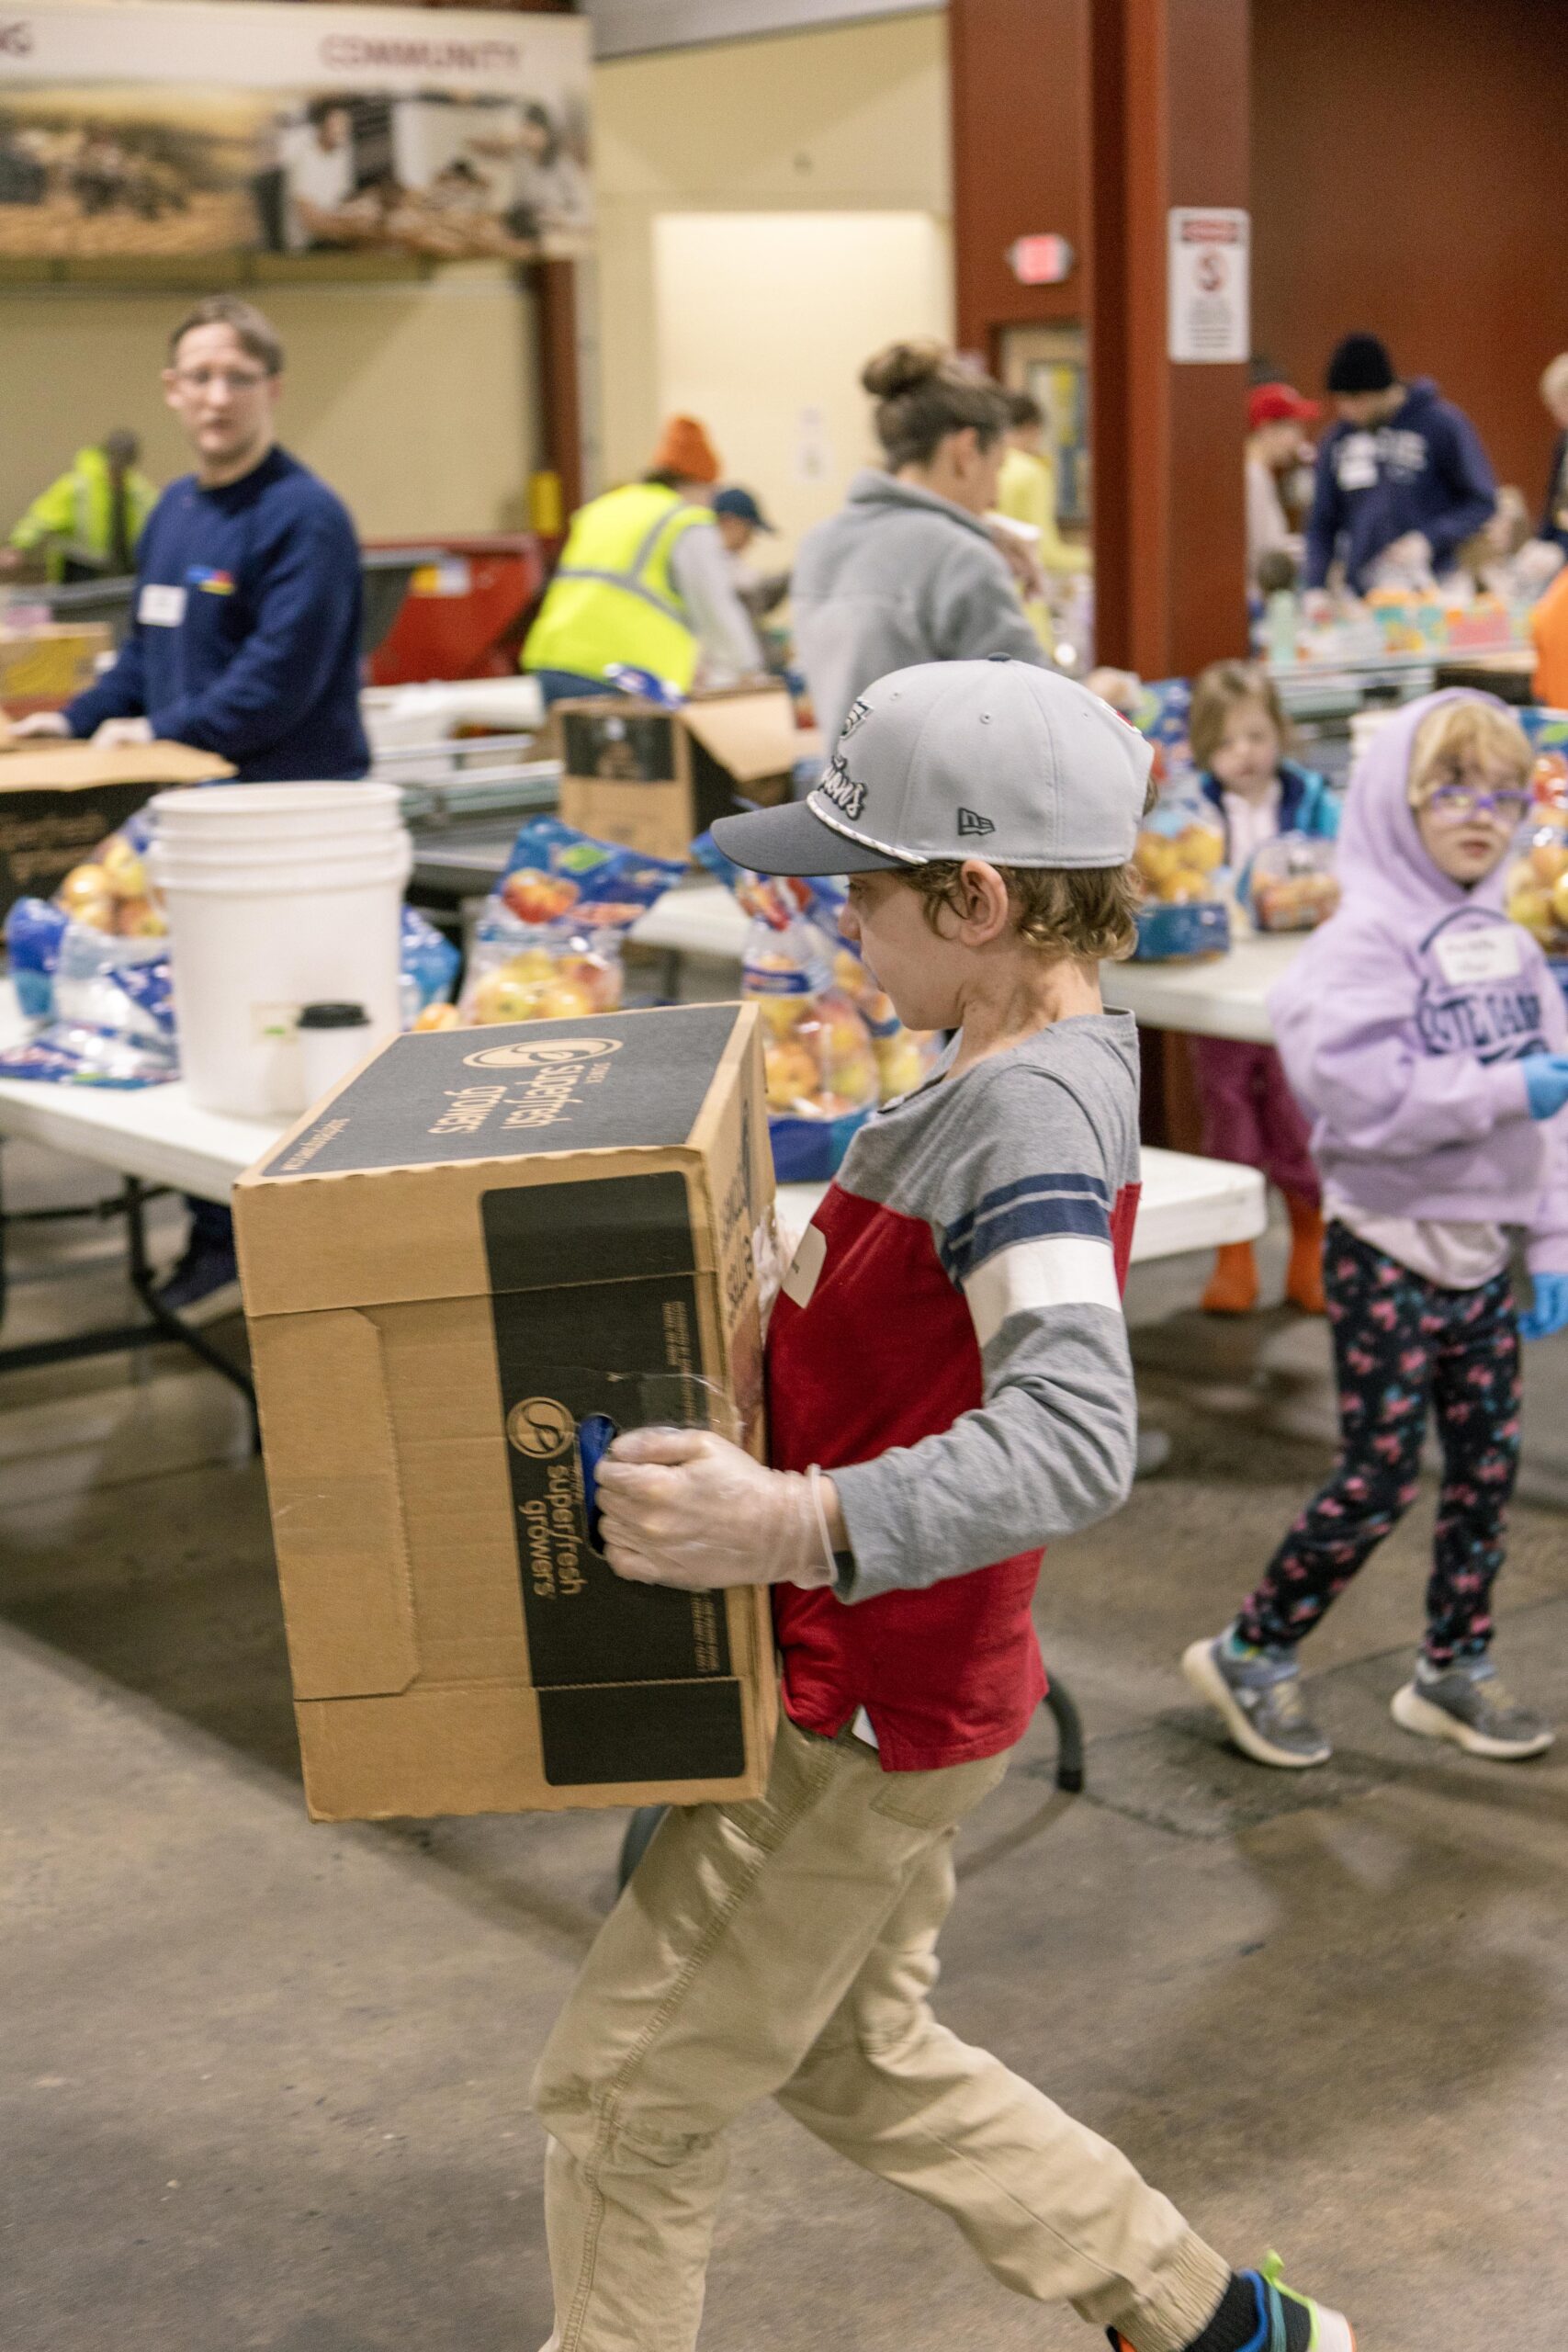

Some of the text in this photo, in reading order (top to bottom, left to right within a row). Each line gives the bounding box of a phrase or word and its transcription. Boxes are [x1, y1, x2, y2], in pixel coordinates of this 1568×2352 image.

[320, 34, 521, 71] COMMUNITY
[427, 1085, 509, 1135] growers
[499, 1063, 586, 1130] superfresh
[518, 1499, 557, 1599] growers
[544, 1464, 589, 1595] superfresh
